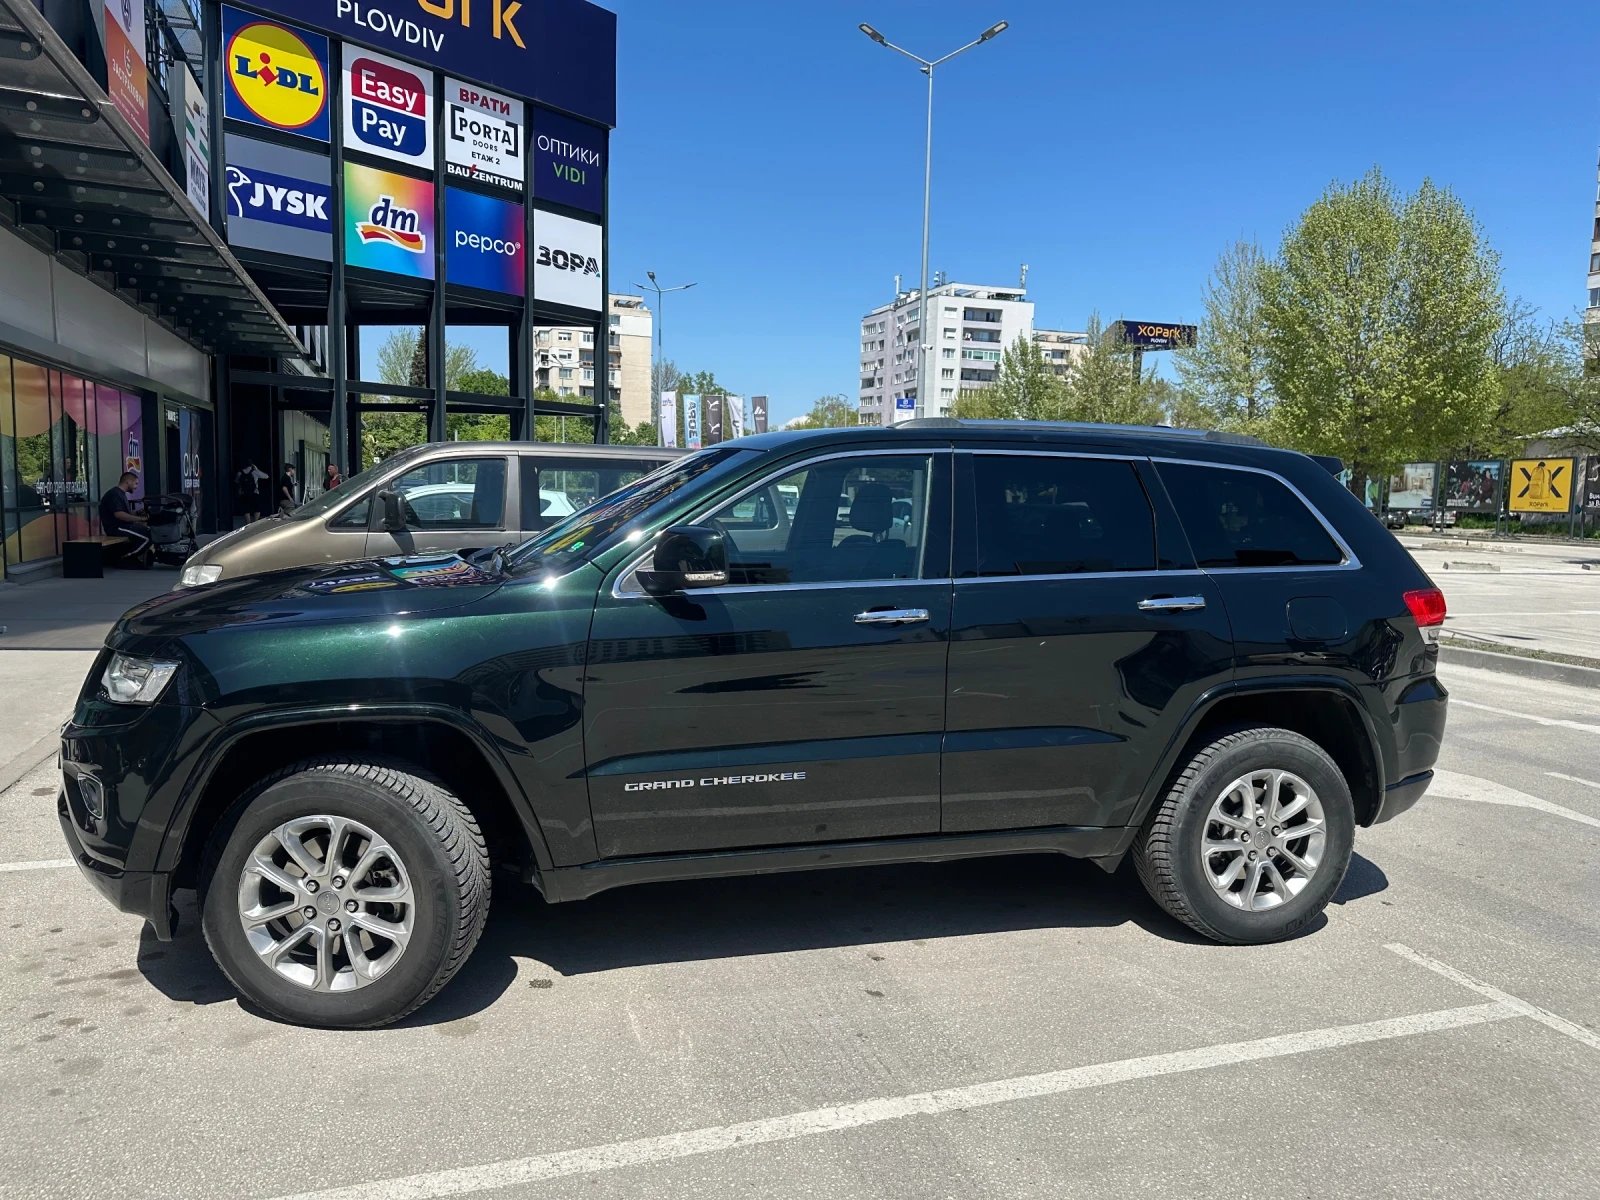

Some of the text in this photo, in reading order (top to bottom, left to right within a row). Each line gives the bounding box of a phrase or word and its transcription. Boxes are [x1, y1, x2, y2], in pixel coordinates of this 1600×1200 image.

[336, 0, 444, 52] PLOVDIV
[361, 68, 418, 112] Easy
[459, 87, 510, 116] ВРАТИ
[362, 107, 407, 146] Pay
[458, 117, 512, 146] PORTA
[471, 151, 501, 166] ЕТАЖ 2
[472, 139, 498, 152] DOORS
[537, 135, 600, 167] ОПТИКИ
[552, 161, 586, 185] VIDI
[249, 182, 329, 221] JYSK
[371, 198, 416, 233] dm
[536, 245, 601, 278] ЗОРА
[1138, 325, 1181, 338] XOPark
[624, 771, 807, 792] GRAND CHEROKEE
